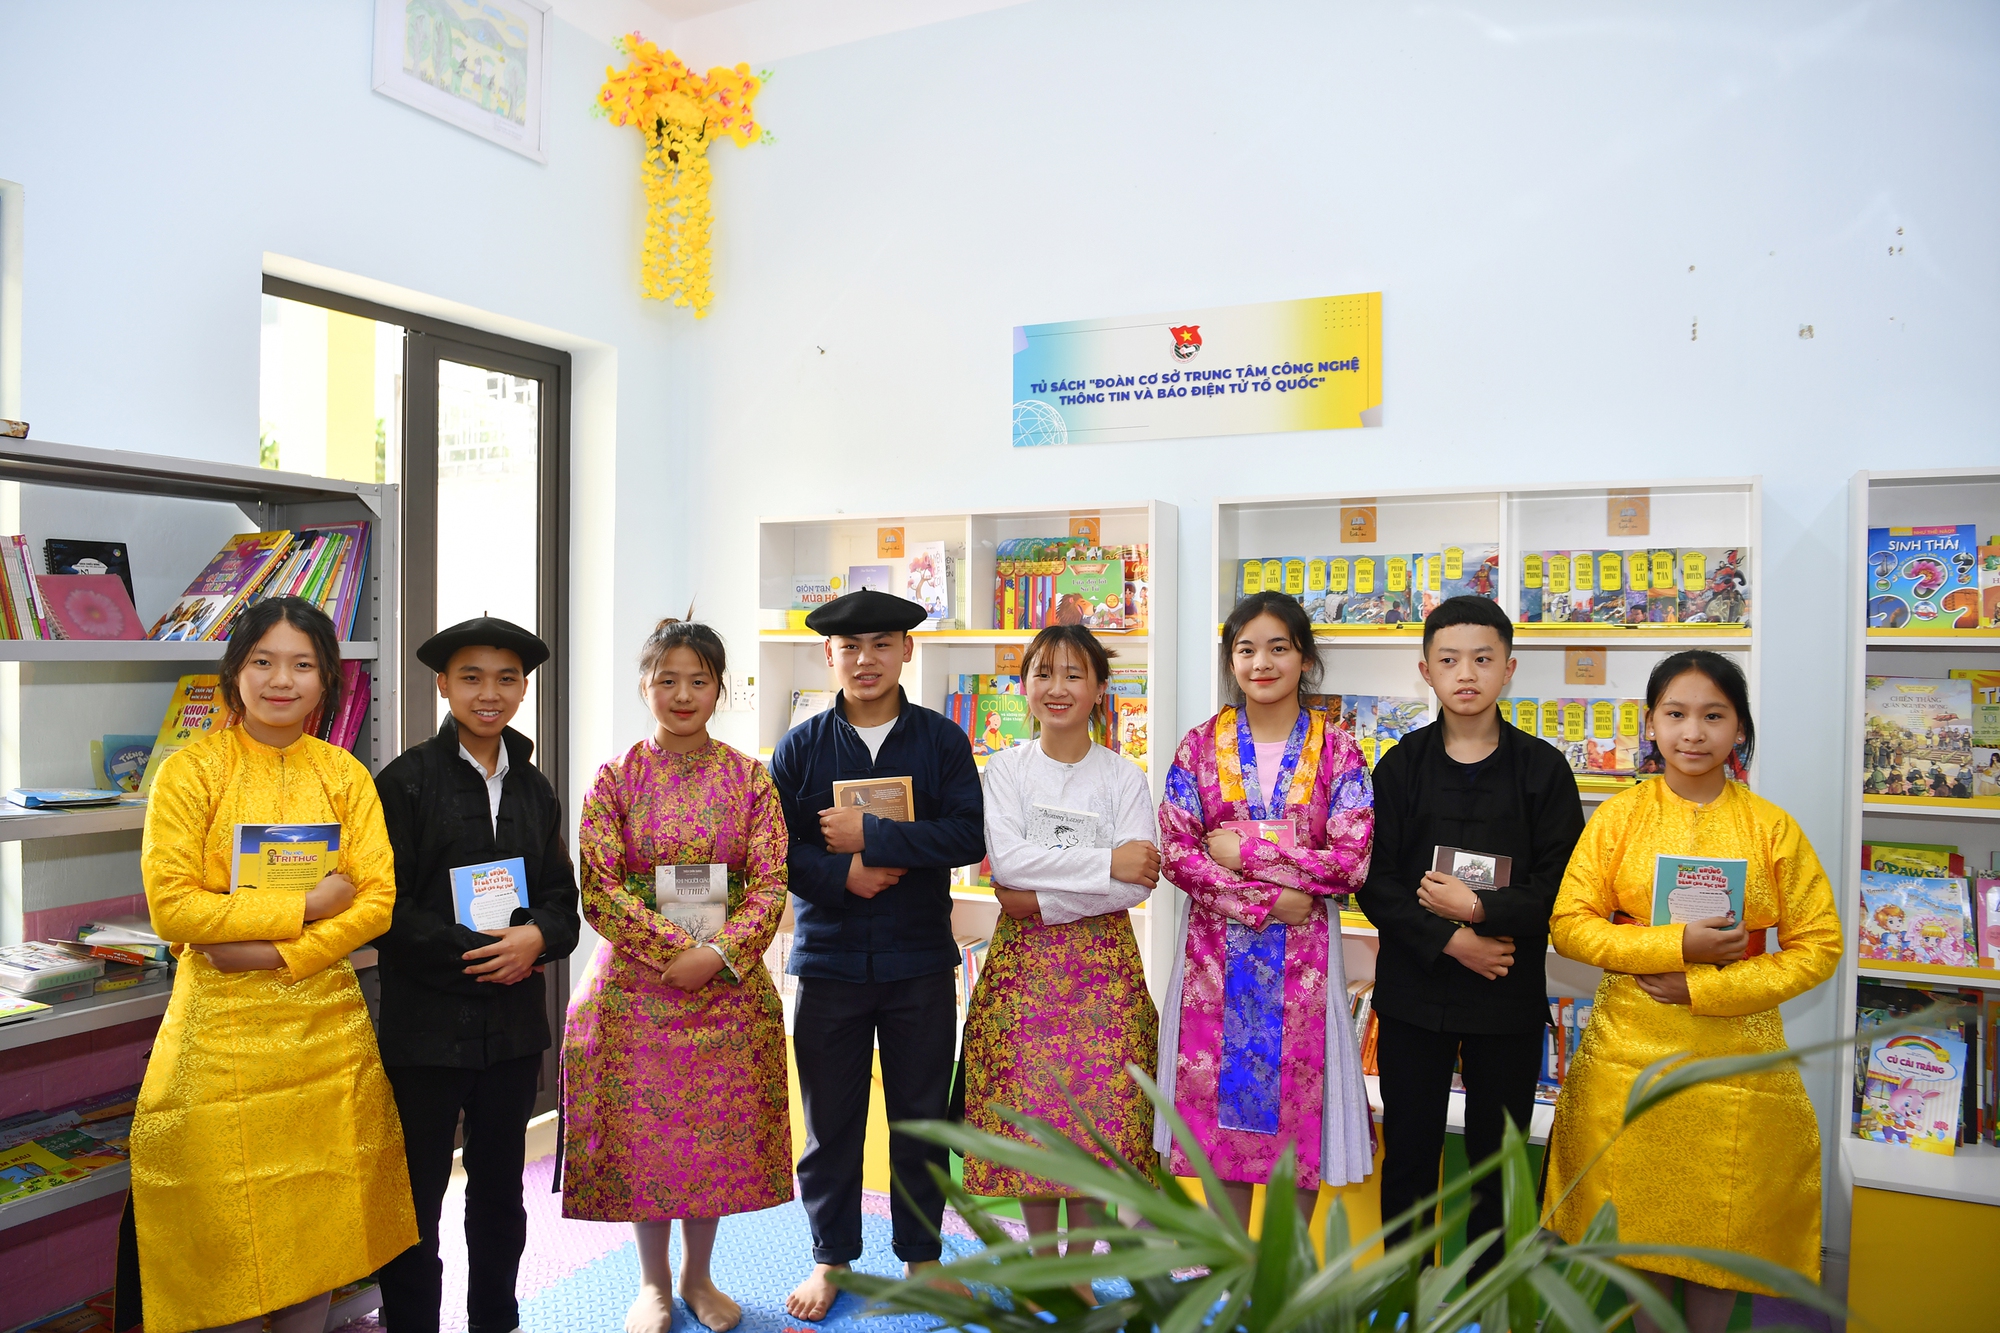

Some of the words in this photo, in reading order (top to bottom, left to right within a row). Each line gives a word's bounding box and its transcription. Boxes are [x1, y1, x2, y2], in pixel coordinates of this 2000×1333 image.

[1030, 379, 1047, 394] TỦ
[1051, 379, 1086, 392] SÁCH
[1090, 375, 1134, 389] "ĐOÀN
[1138, 373, 1158, 386] CƠ
[1162, 369, 1180, 384] SỞ
[1184, 369, 1232, 382] TRUNG
[1236, 364, 1268, 378] TÂM
[1272, 362, 1314, 375] CÔNG
[1318, 356, 1360, 373] NGHỆ
[1059, 392, 1105, 406] THÔNG
[1108, 391, 1130, 402] TIN
[1134, 387, 1154, 400] VÀ
[1158, 386, 1187, 398] BÁO
[1191, 382, 1225, 398] ĐIỆN
[1229, 379, 1249, 394] TỬ
[1252, 376, 1272, 392] TỔ
[1276, 374, 1326, 392] QUỐC"
[1888, 540, 1921, 552] SINH
[1924, 536, 1959, 551] THÁI
[183, 705, 209, 716] KHOA
[980, 695, 1024, 712] caillou
[1887, 1055, 1898, 1064] CỦ
